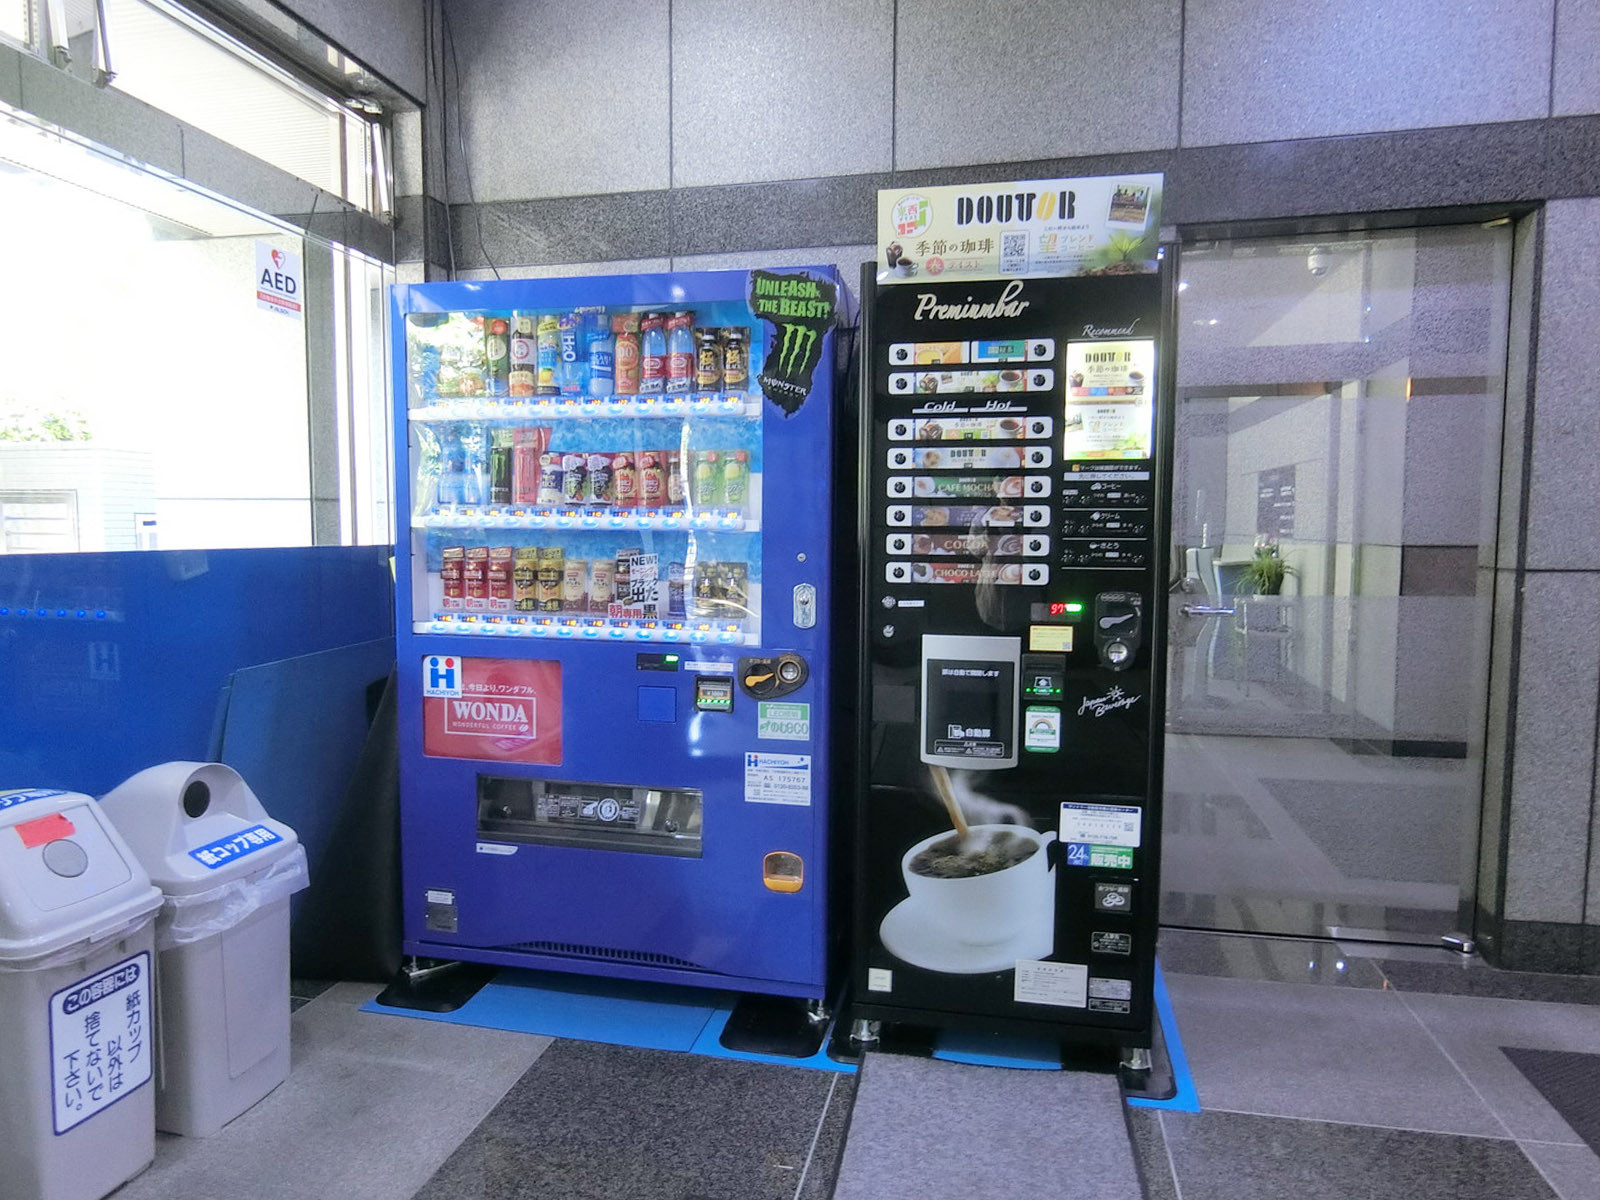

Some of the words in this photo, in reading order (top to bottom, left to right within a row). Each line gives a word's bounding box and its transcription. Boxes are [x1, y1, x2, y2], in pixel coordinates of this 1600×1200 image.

[957, 190, 1076, 225] DOUTOR
[915, 237, 995, 257] 季節の珈琲
[260, 268, 297, 294] AED
[759, 299, 778, 313] THE
[780, 298, 831, 318] BEAST!
[1081, 318, 1139, 338] Recommend
[562, 334, 577, 362] H2O
[762, 376, 807, 396] MONSTER
[924, 401, 957, 411] Cold
[985, 400, 1012, 410] Hot
[943, 540, 989, 550] COCOA
[631, 555, 658, 566] NEW!
[934, 569, 968, 578] CHOCO
[631, 586, 659, 603] 出た
[452, 700, 528, 723] WONDA
[196, 827, 277, 865] 紙コップ専用
[1068, 844, 1085, 860] 24
[67, 966, 138, 1011] この容器には
[126, 989, 142, 1064] 紙カップ
[84, 1010, 103, 1102] 捨てないで
[107, 1035, 123, 1093] 以外は
